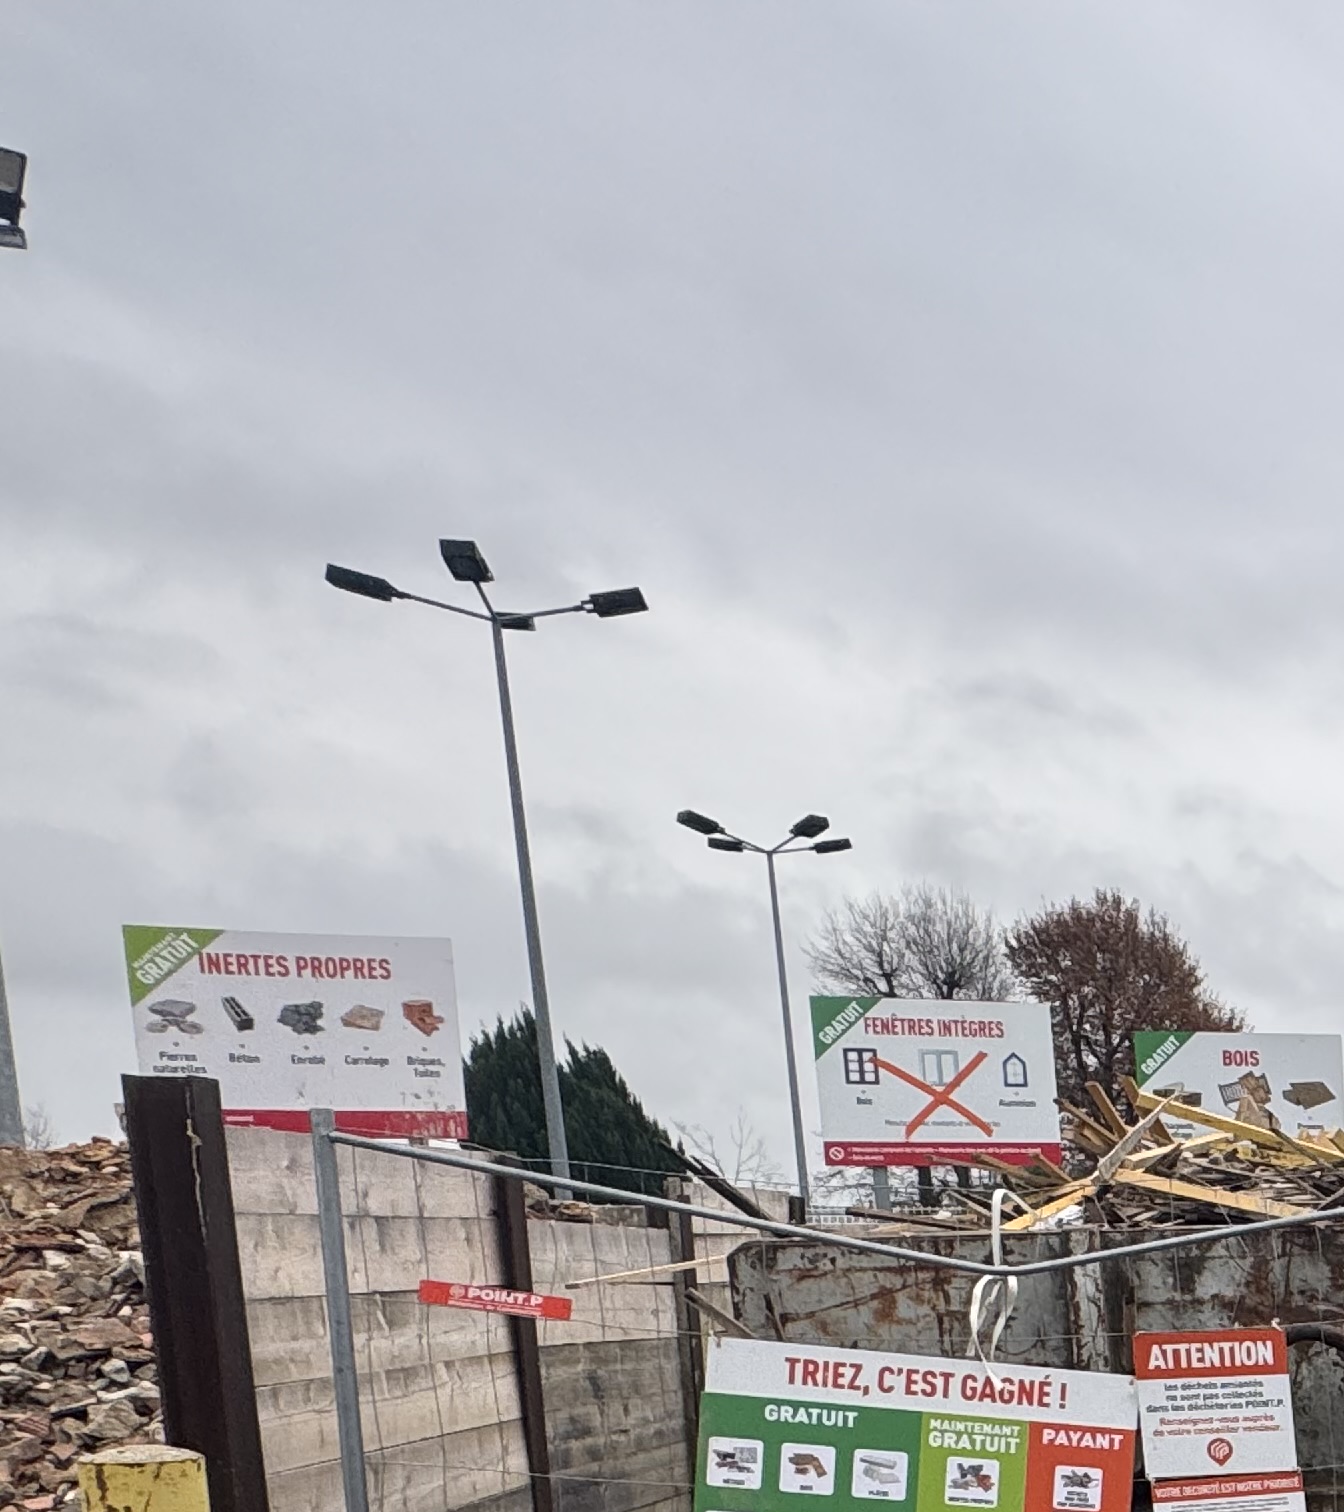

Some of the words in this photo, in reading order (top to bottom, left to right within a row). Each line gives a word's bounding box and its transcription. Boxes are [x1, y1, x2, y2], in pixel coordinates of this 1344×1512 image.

[135, 932, 200, 984] GRATUIT
[198, 952, 290, 977] INERTES
[295, 955, 392, 980] PROPRES
[818, 1000, 864, 1045] GRATUIT
[864, 1012, 934, 1036] FENÊTRES
[1140, 1035, 1180, 1075] GRATUIT
[1222, 1050, 1260, 1067] BOIS
[467, 1287, 544, 1306] POINT.P
[1147, 1340, 1275, 1370] ATTENTION
[785, 1356, 870, 1397] TRIEZ,
[878, 1366, 956, 1400] C'EST
[960, 1374, 1053, 1409] GAGNÉ
[1059, 1382, 1068, 1409] !
[764, 1404, 859, 1428] GRATUIT
[929, 1418, 1021, 1438] MAINTENANT
[928, 1431, 1020, 1454] GRATUIT
[1042, 1428, 1124, 1450] PAYANT
